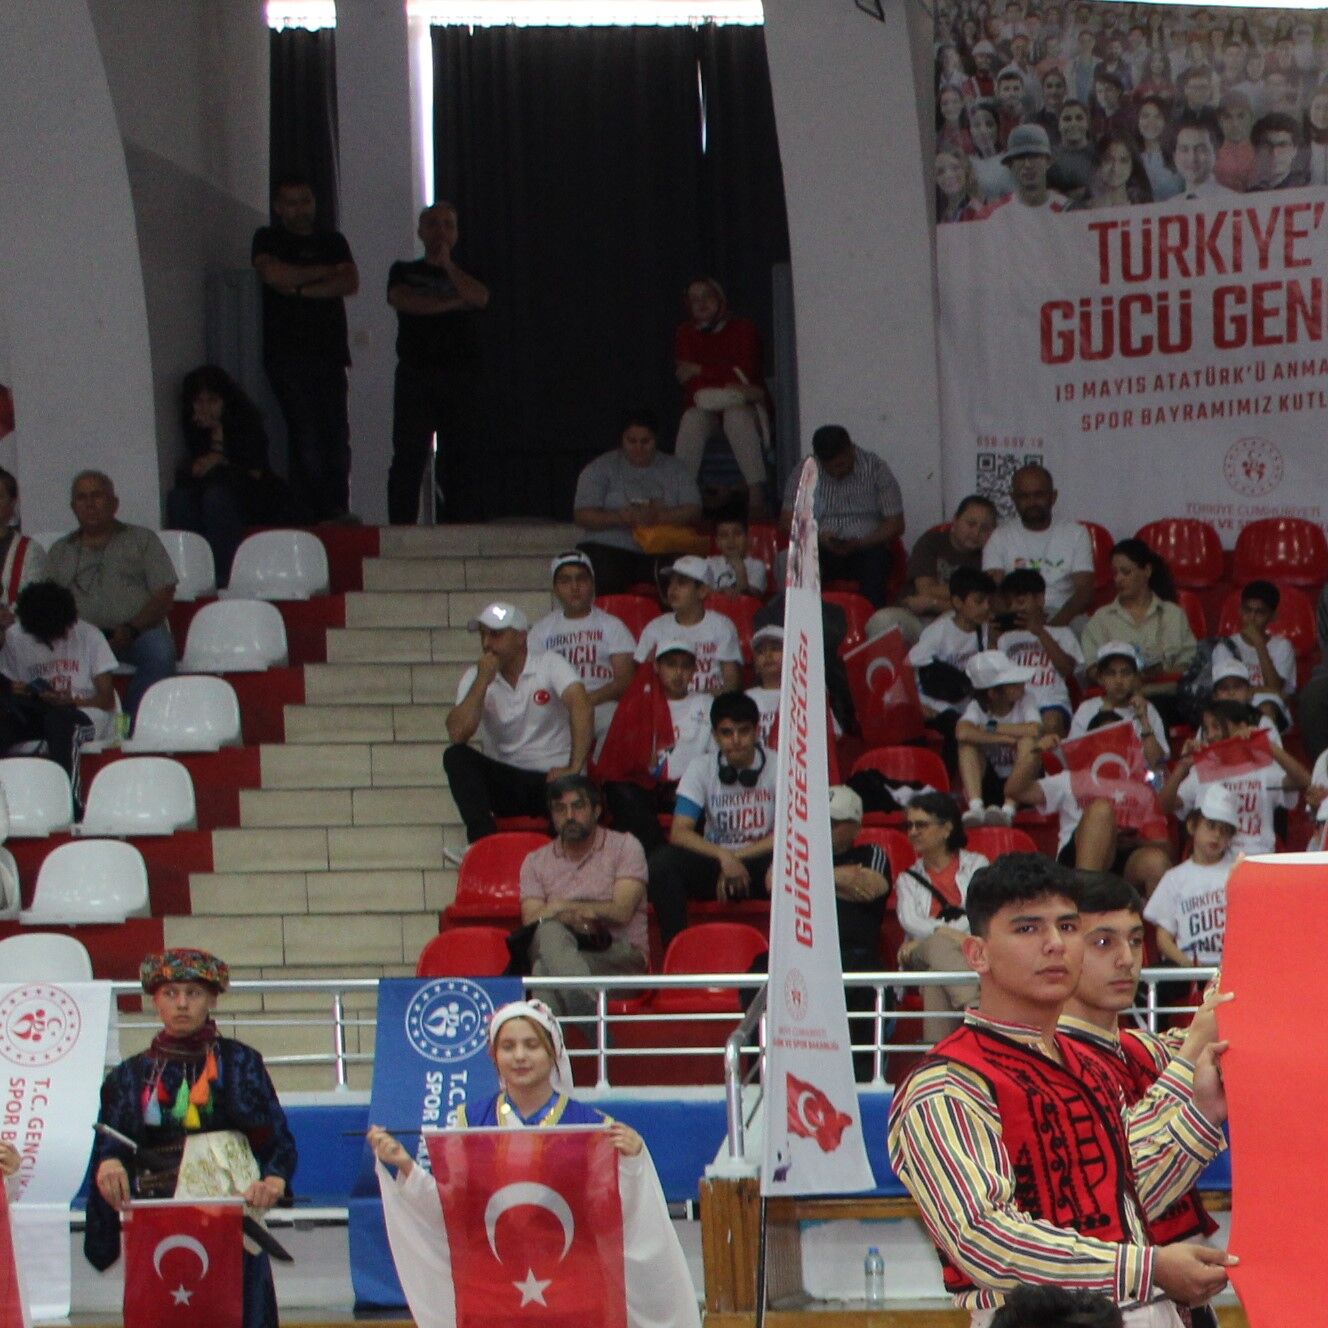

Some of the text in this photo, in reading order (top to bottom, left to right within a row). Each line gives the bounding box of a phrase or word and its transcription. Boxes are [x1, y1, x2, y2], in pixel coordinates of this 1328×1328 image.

[1040, 290, 1192, 365] GÜCÜ
[1083, 377, 1146, 399] MAYIS
[1153, 360, 1266, 391] ATATÜRK'Ü
[1274, 359, 1328, 379] ANMA
[1080, 409, 1134, 432] SPOR
[1141, 395, 1272, 426] BAYRAMIMIZ
[795, 832, 813, 948] GÜCÜ
[1189, 907, 1225, 937] GÜC
[4, 1077, 26, 1128] SPOR
[31, 1077, 51, 1111] T.C.
[423, 1070, 443, 1124] SPOR
[448, 1069, 468, 1109] T.C.
